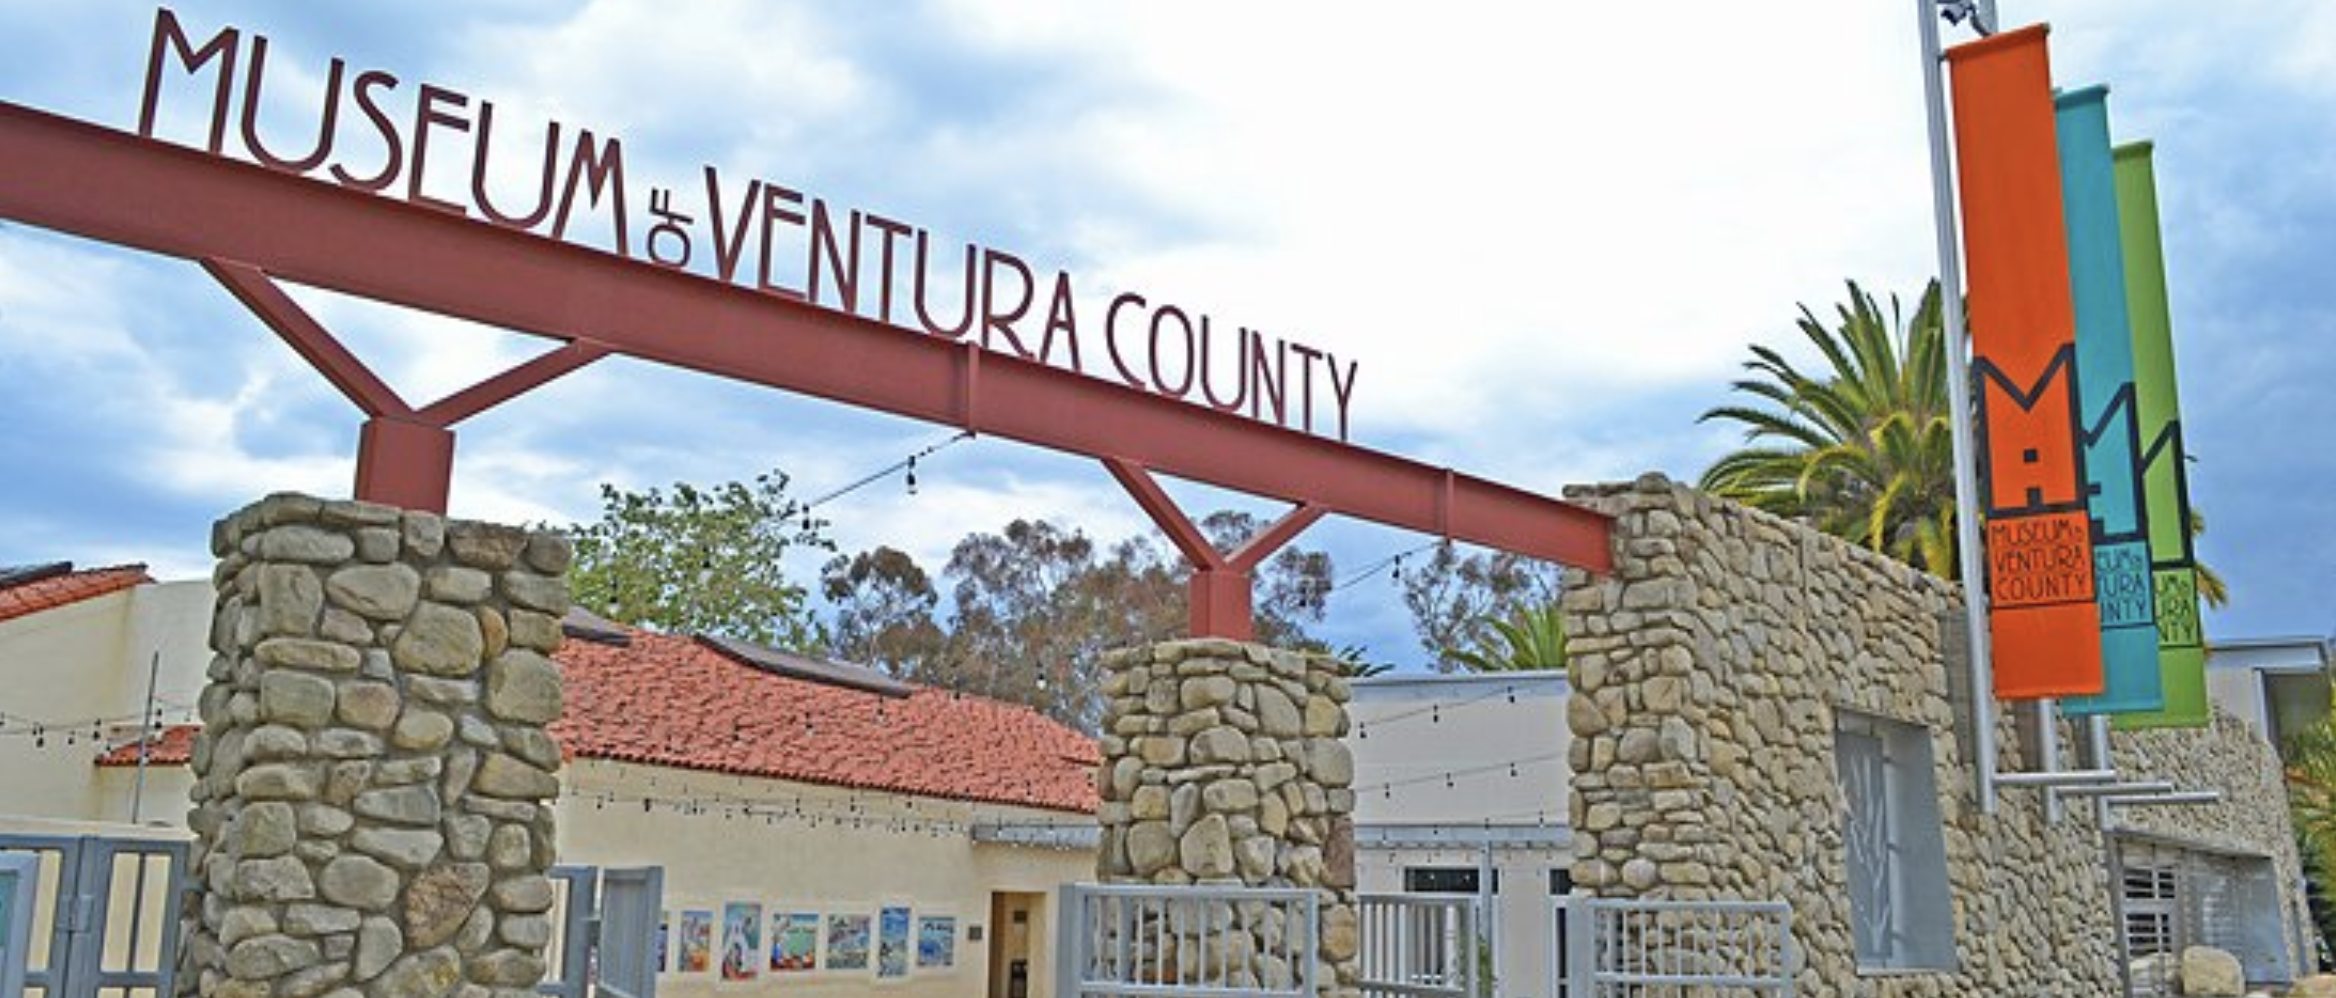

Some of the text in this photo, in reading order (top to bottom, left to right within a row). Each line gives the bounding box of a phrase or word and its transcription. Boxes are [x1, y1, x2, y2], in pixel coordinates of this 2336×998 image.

[138, 7, 1359, 443] MUSEUM OF VENTURA COUNTY
[1992, 517, 2071, 547] MUSEUM
[1995, 545, 2085, 574] VENTURA
[1996, 574, 2086, 601] COUNTY
